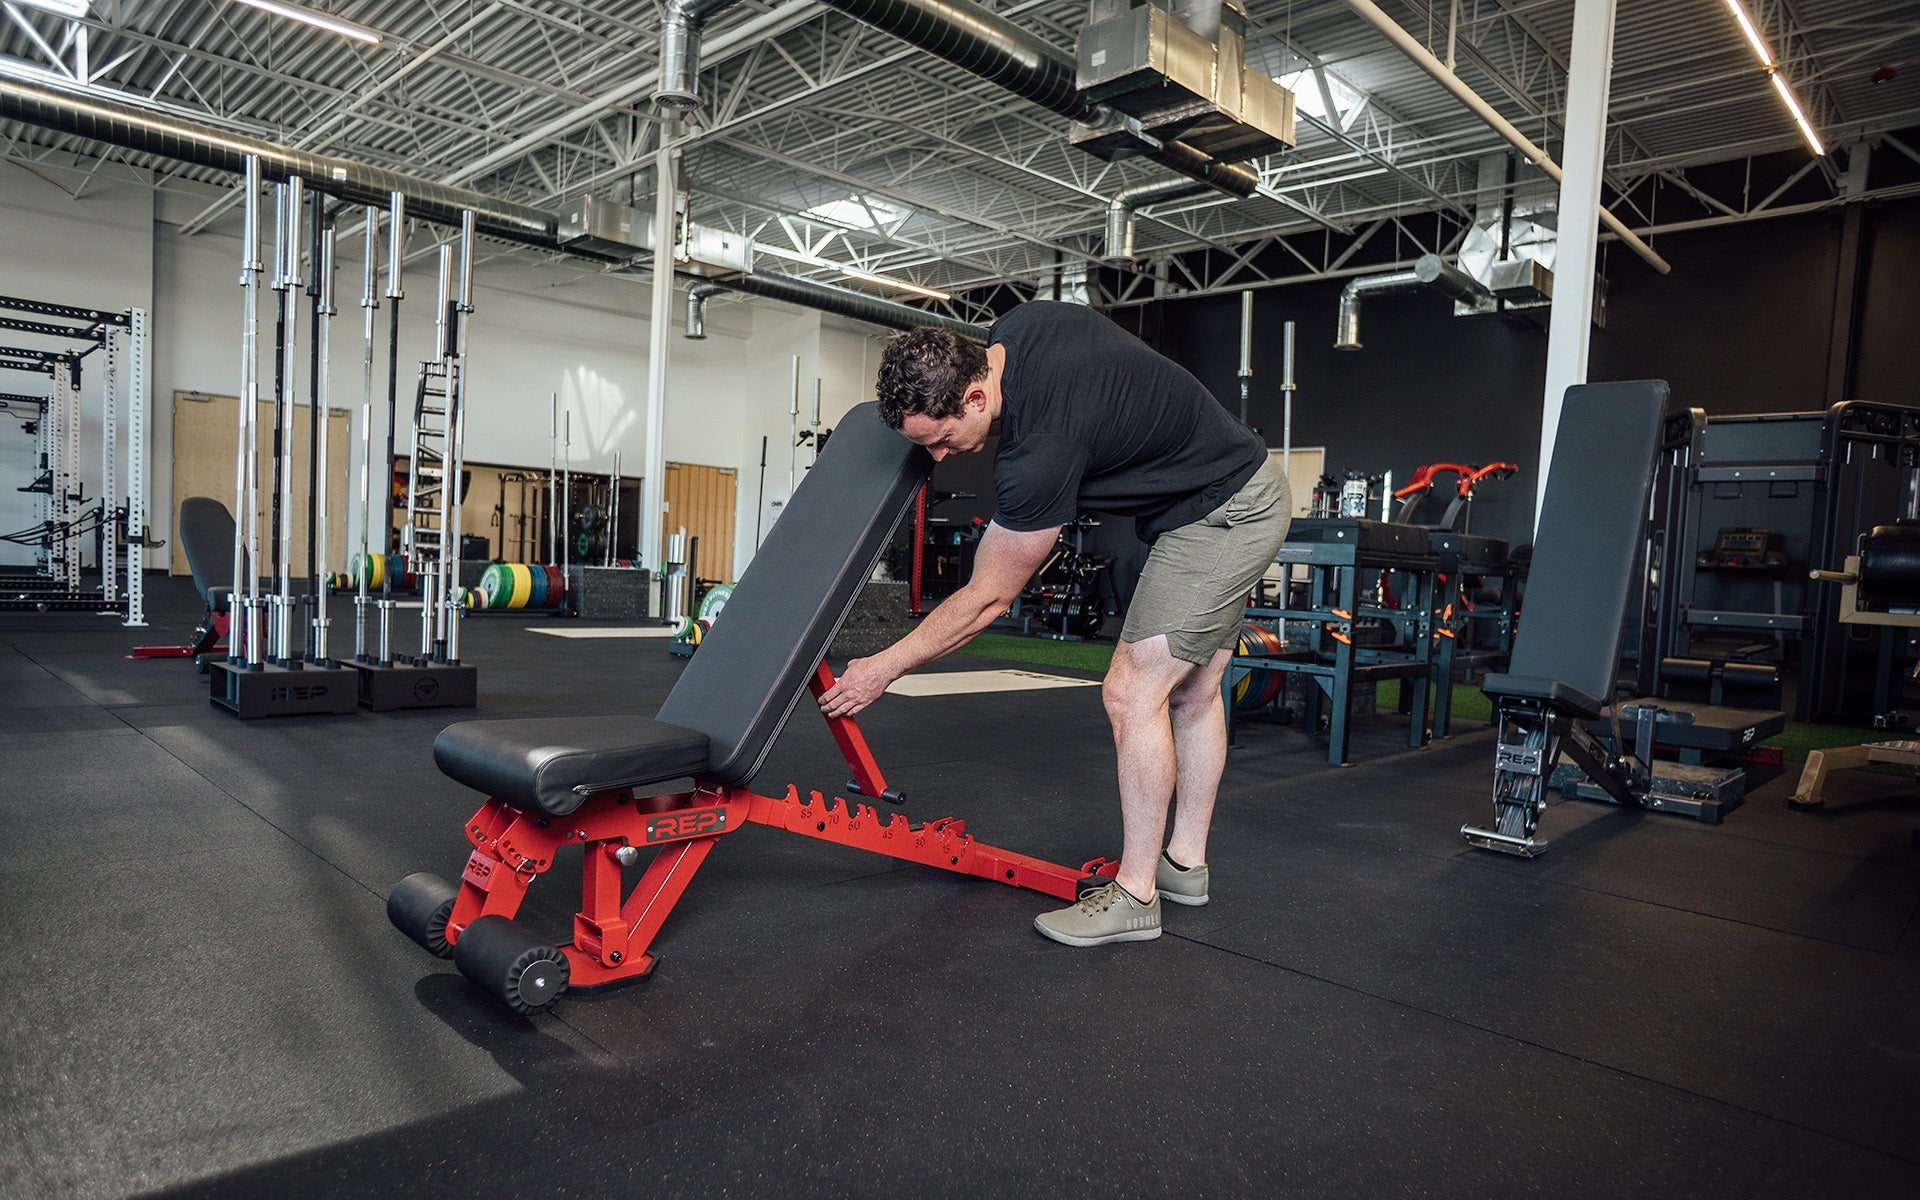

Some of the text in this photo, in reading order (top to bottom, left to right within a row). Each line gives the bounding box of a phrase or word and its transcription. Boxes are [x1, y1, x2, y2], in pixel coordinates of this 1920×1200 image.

[271, 686, 329, 704] REP
[1499, 752, 1536, 765] REP
[655, 811, 718, 839] REP
[800, 807, 812, 819] 85
[828, 814, 840, 825] 70
[848, 821, 861, 831] 60
[882, 828, 893, 840] 45
[915, 837, 926, 848] 30
[467, 858, 491, 877] REP
